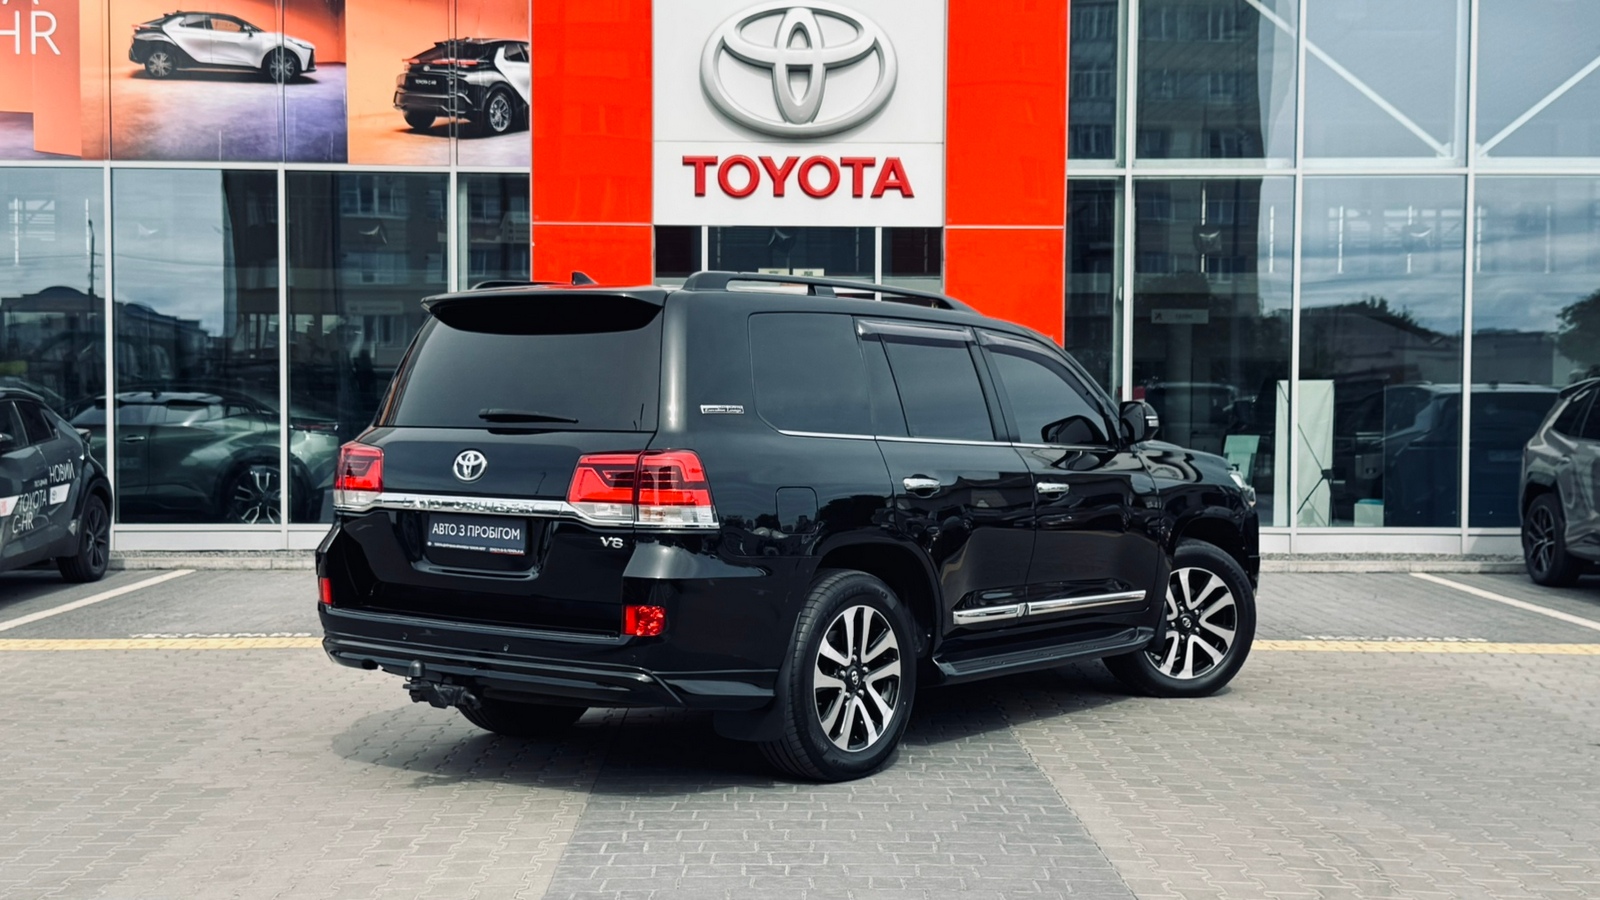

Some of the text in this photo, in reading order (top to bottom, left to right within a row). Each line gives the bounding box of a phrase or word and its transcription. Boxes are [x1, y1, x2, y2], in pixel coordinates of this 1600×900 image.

[682, 154, 915, 199] TOYOTA
[49, 458, 76, 484] НОВИЙ
[18, 489, 48, 512] TOYOTA
[12, 511, 35, 534] C-HR
[432, 522, 521, 541] АВТО З ПРОБІГОМ
[600, 536, 624, 549] V8
